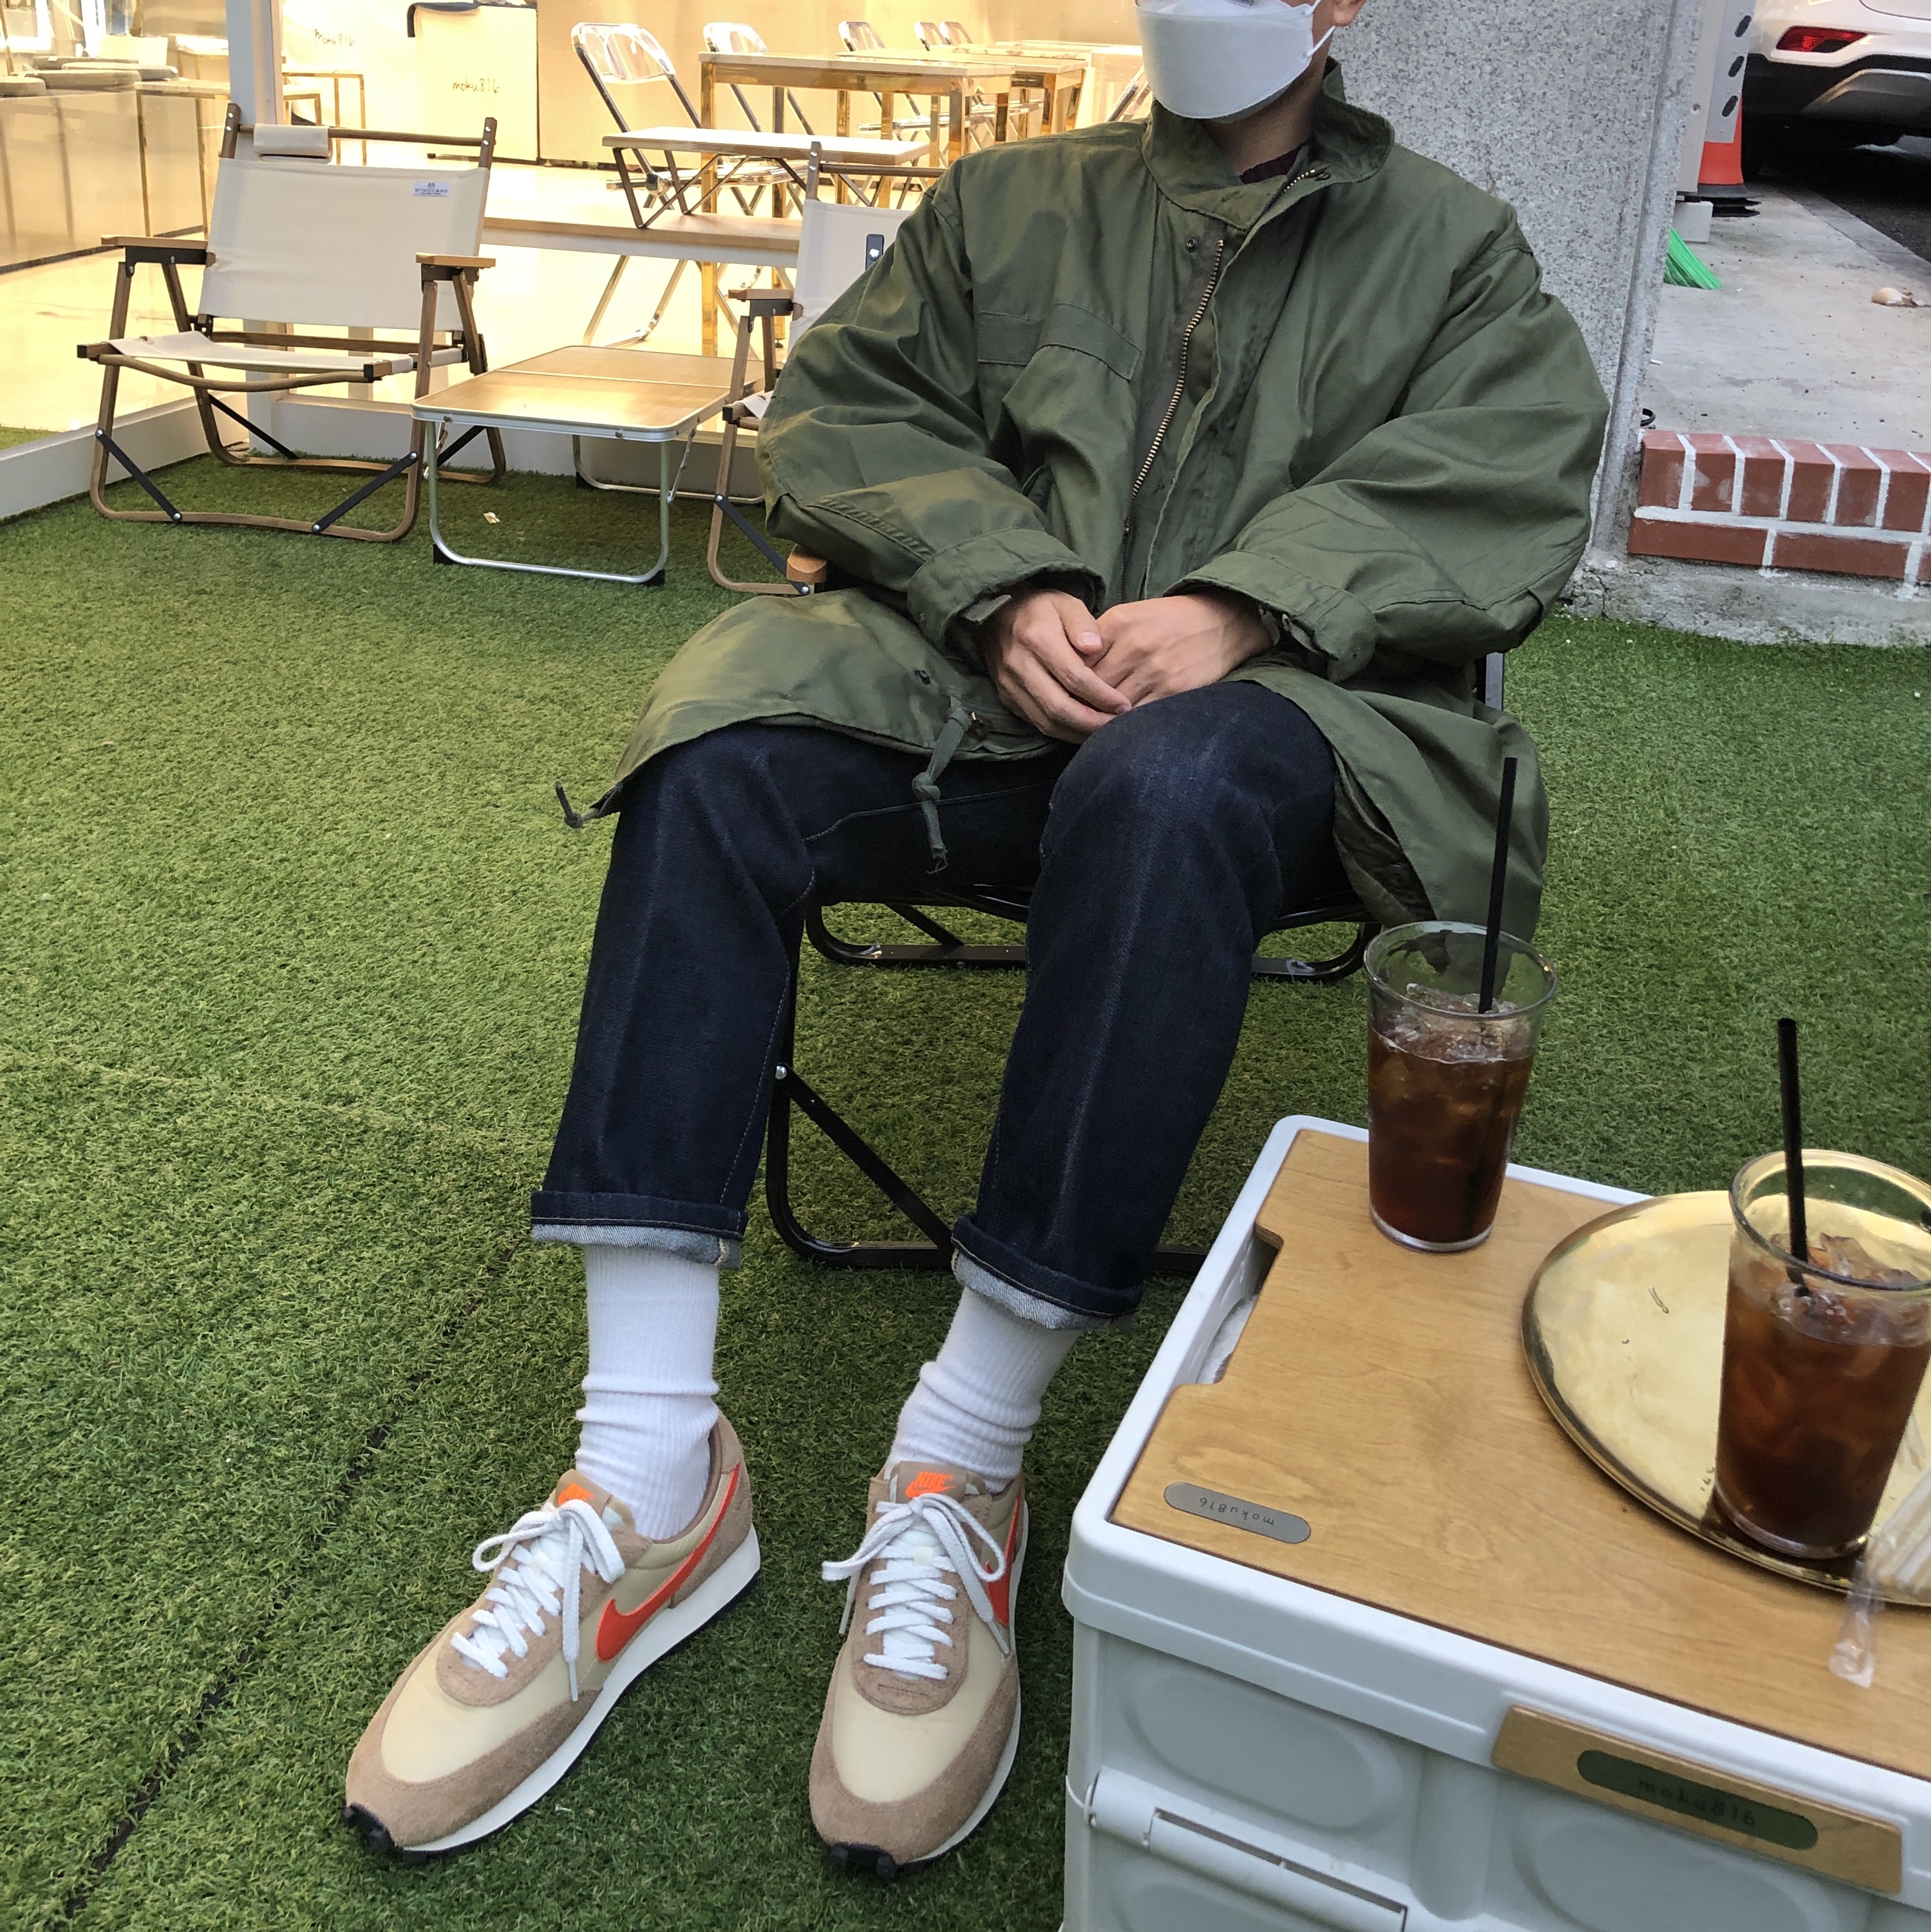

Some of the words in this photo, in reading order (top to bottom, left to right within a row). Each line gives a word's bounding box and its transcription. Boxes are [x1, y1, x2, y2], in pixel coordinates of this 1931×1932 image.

[452, 74, 500, 94] moku816
[913, 1471, 946, 1489] NIKE
[1199, 1497, 1275, 1526] moku816
[1639, 1779, 1755, 1826] moku816
